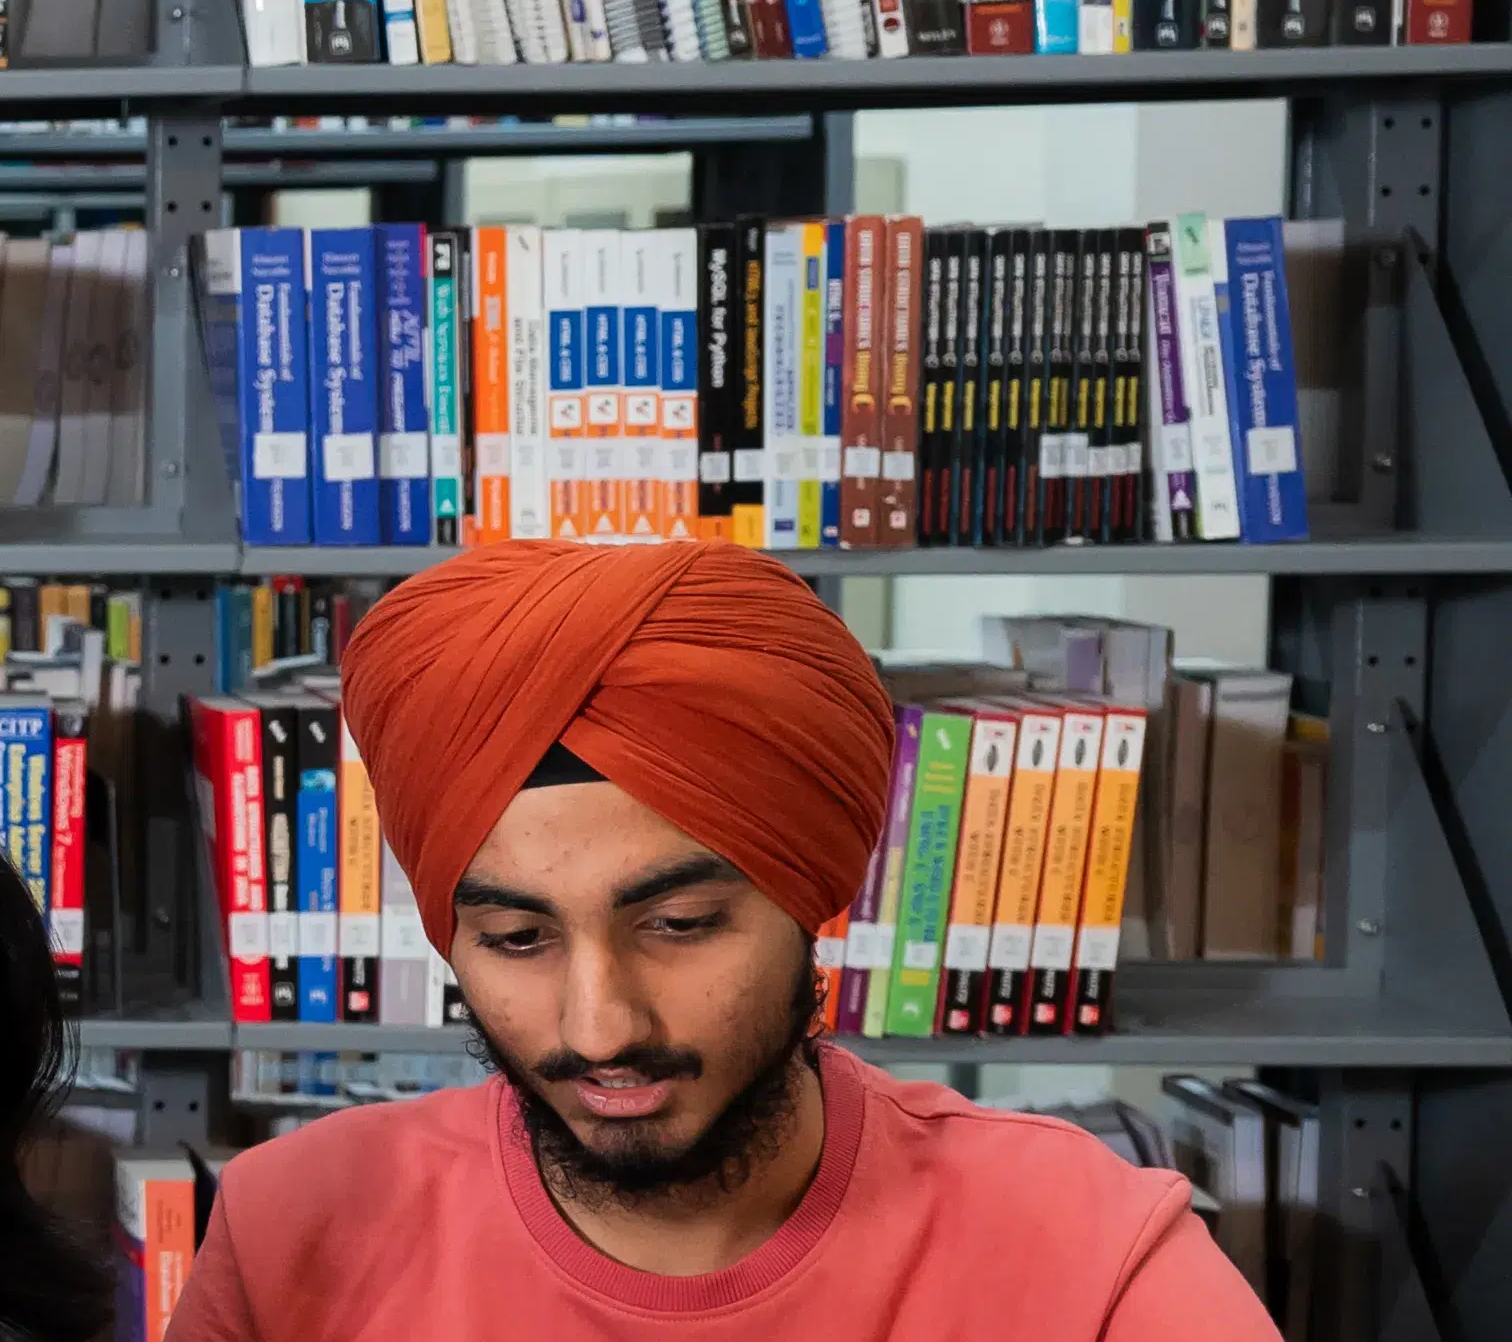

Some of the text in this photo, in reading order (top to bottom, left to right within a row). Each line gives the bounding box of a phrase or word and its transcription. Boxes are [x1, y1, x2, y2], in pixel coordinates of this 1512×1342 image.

[258, 285, 273, 364] Database
[328, 283, 344, 363] Database
[711, 306, 727, 387] for Python
